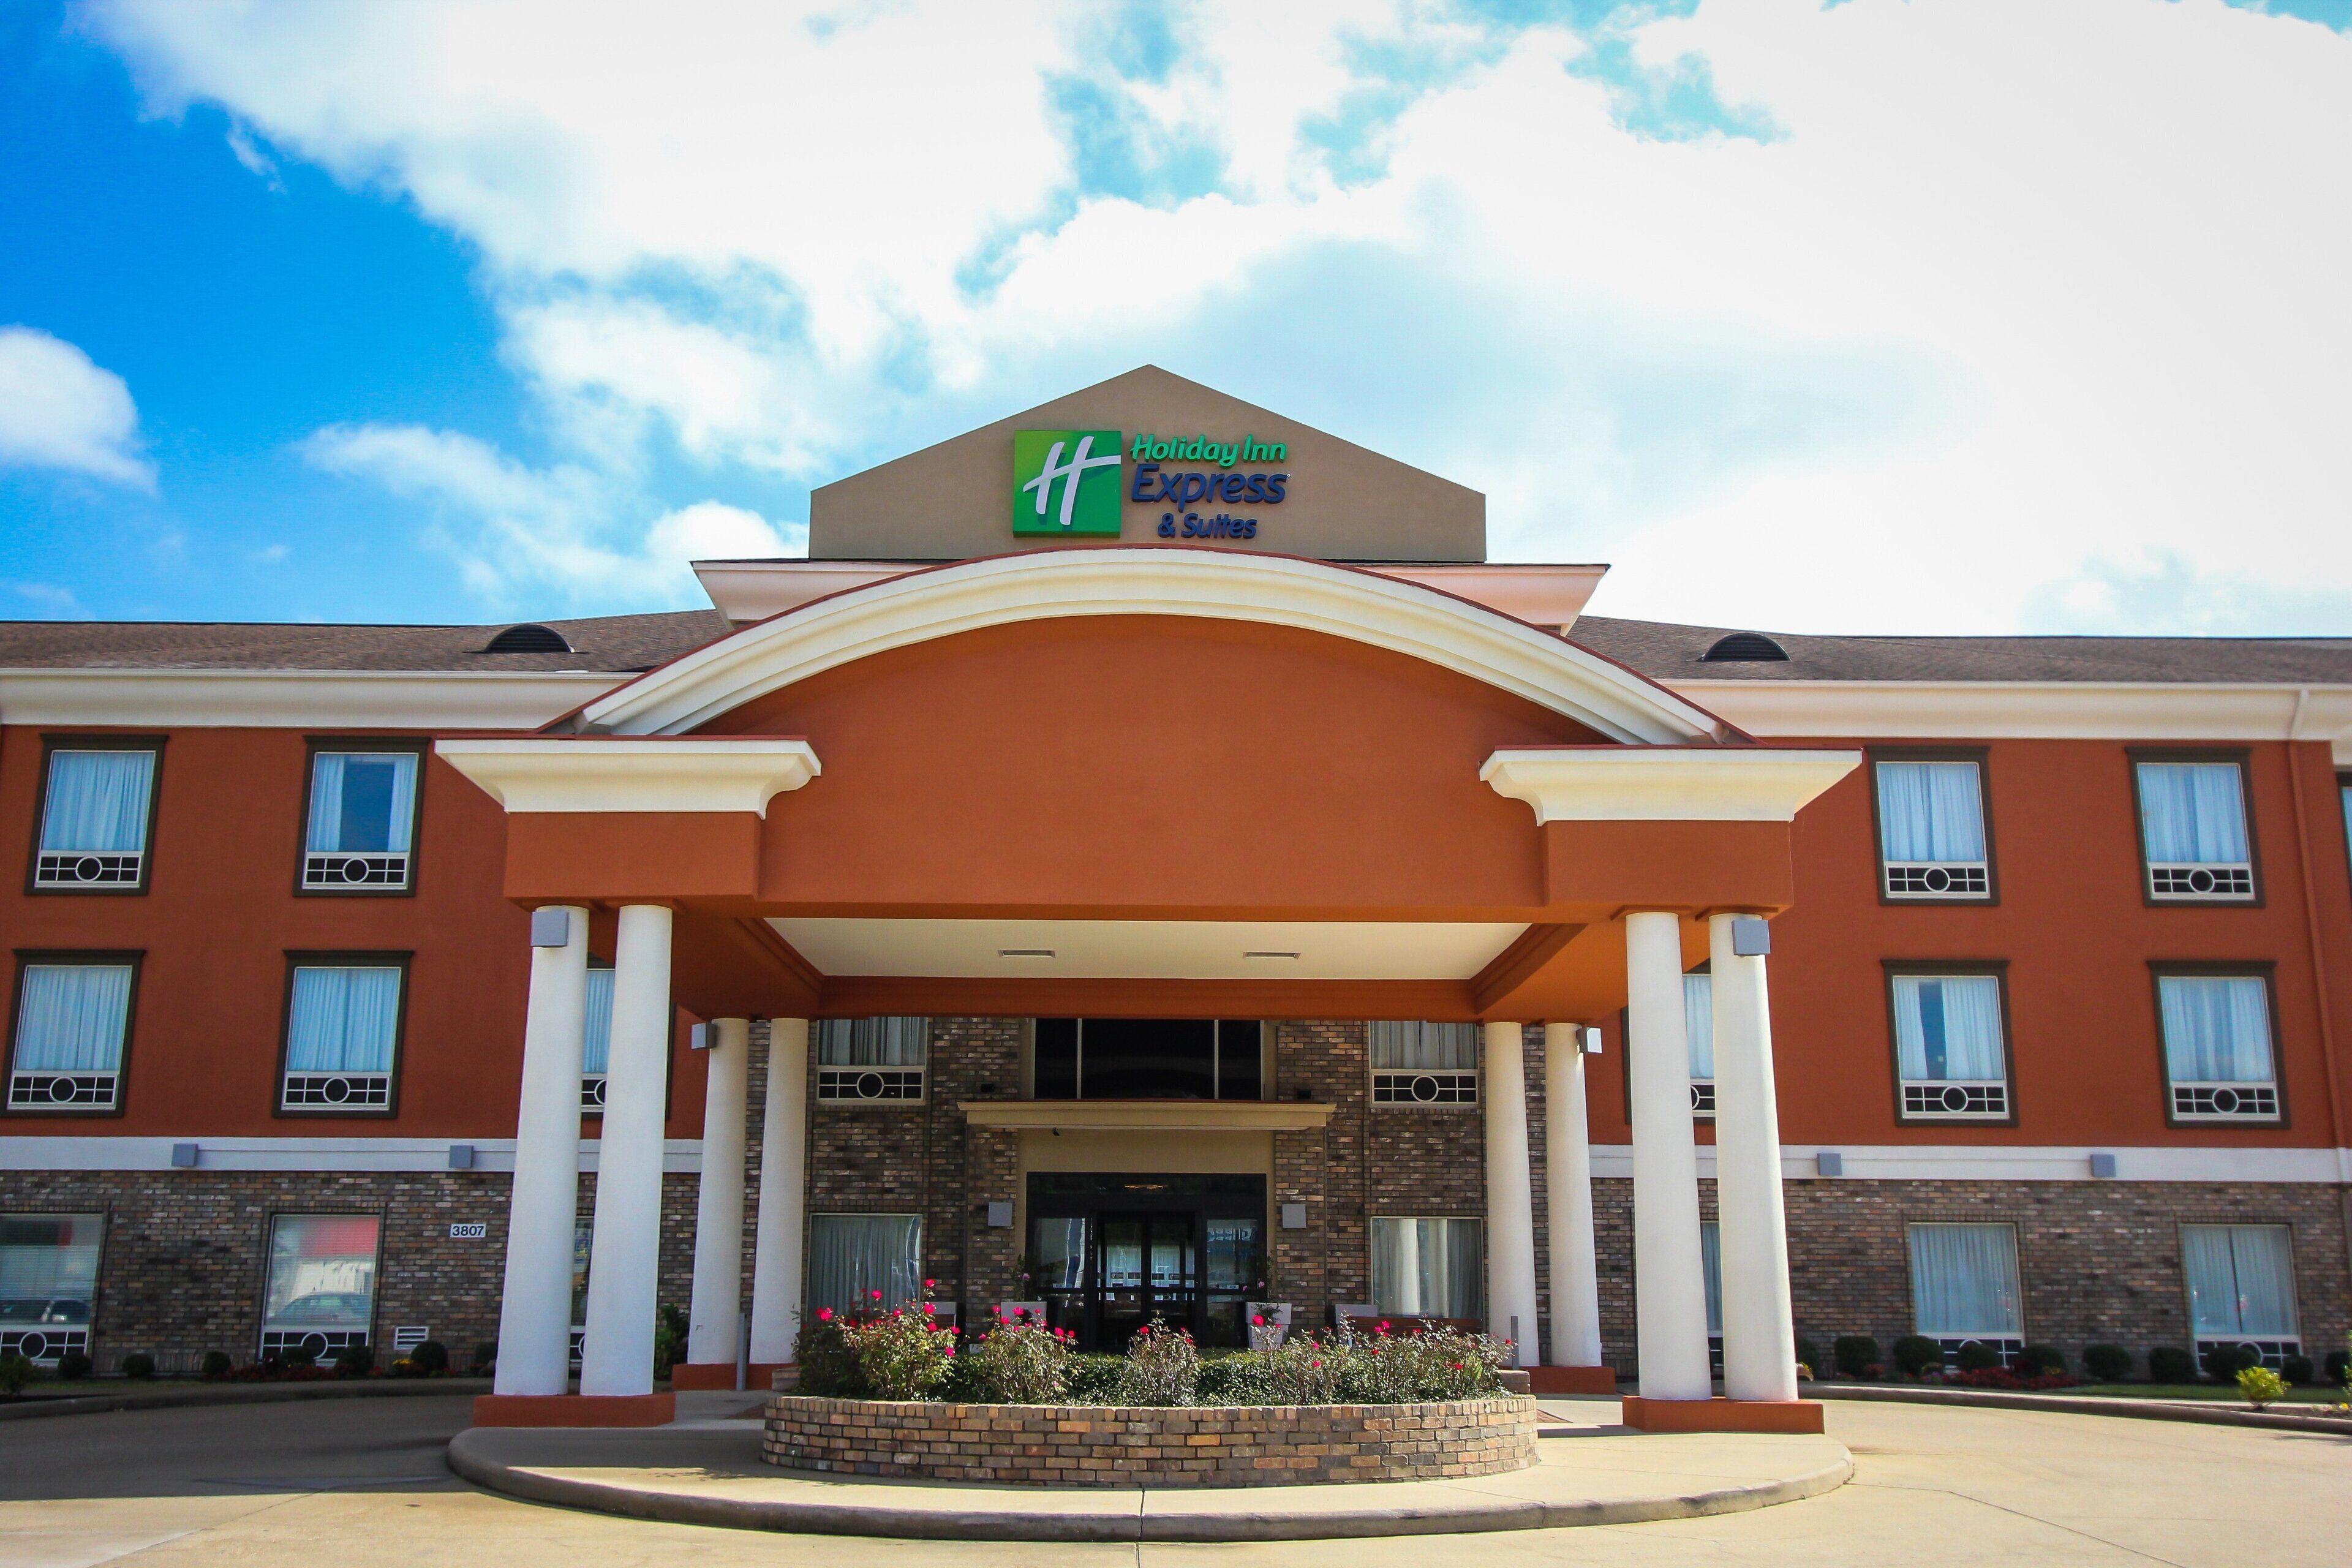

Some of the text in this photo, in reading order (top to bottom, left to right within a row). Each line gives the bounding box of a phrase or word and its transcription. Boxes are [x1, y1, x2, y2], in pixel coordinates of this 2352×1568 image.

[1130, 433, 1287, 469] Holiday Inn
[1131, 464, 1287, 513] Express
[1157, 512, 1257, 539] & Suites
[452, 1226, 484, 1236] 3807
